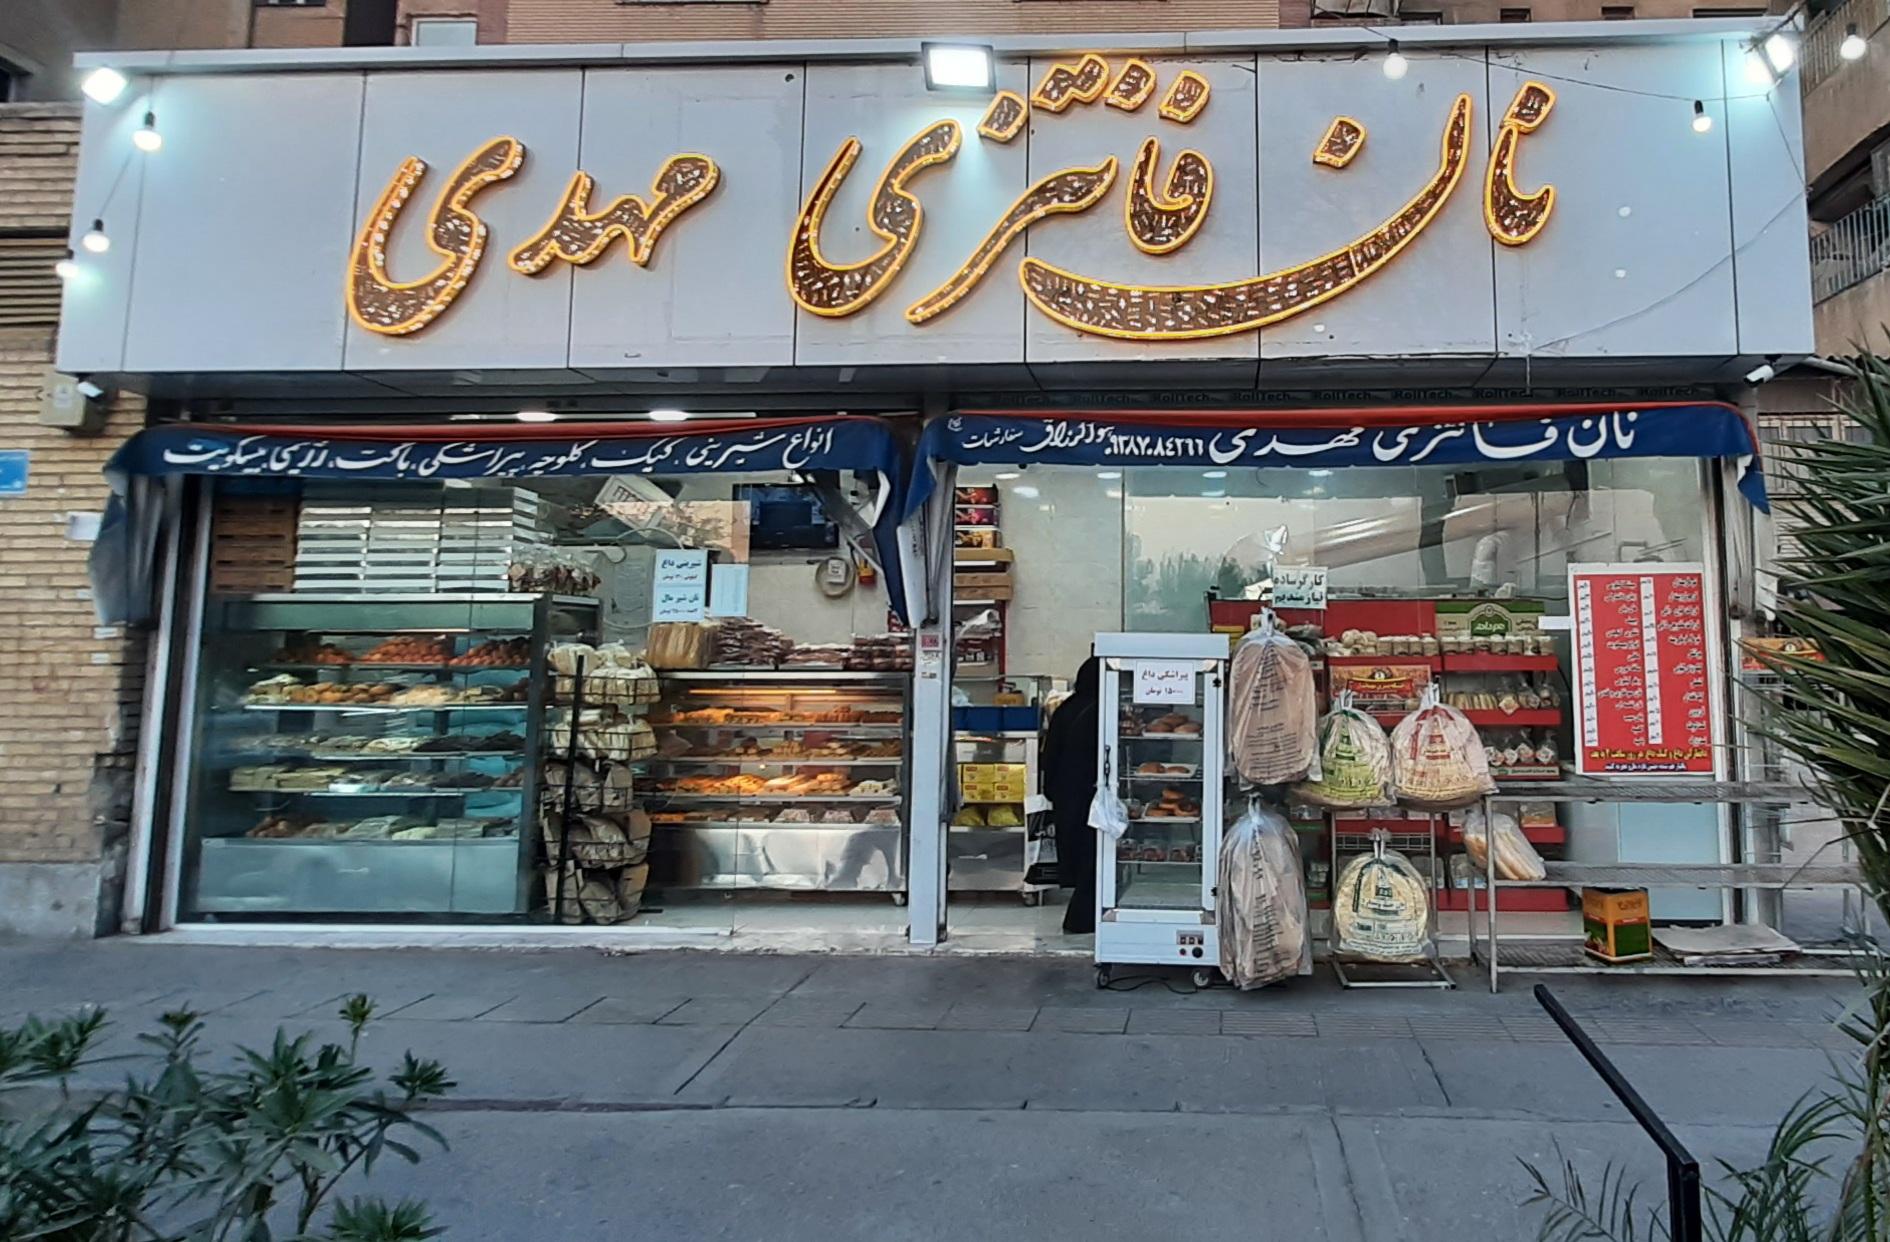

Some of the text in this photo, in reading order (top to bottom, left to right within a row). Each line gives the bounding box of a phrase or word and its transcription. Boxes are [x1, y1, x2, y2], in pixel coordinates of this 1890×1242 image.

[345, 52, 1556, 341] نان فانتزی مهدی
[163, 434, 268, 474] بیسکویت
[781, 425, 836, 470] انواع
[960, 426, 1025, 450] سفارشات
[1208, 425, 1366, 465] مهدی
[1371, 417, 1560, 463] فانتزی
[1567, 409, 1640, 459] نان
[1272, 573, 1325, 590] کارگر ساده
[1141, 668, 1189, 681] پیراشکی داغ
